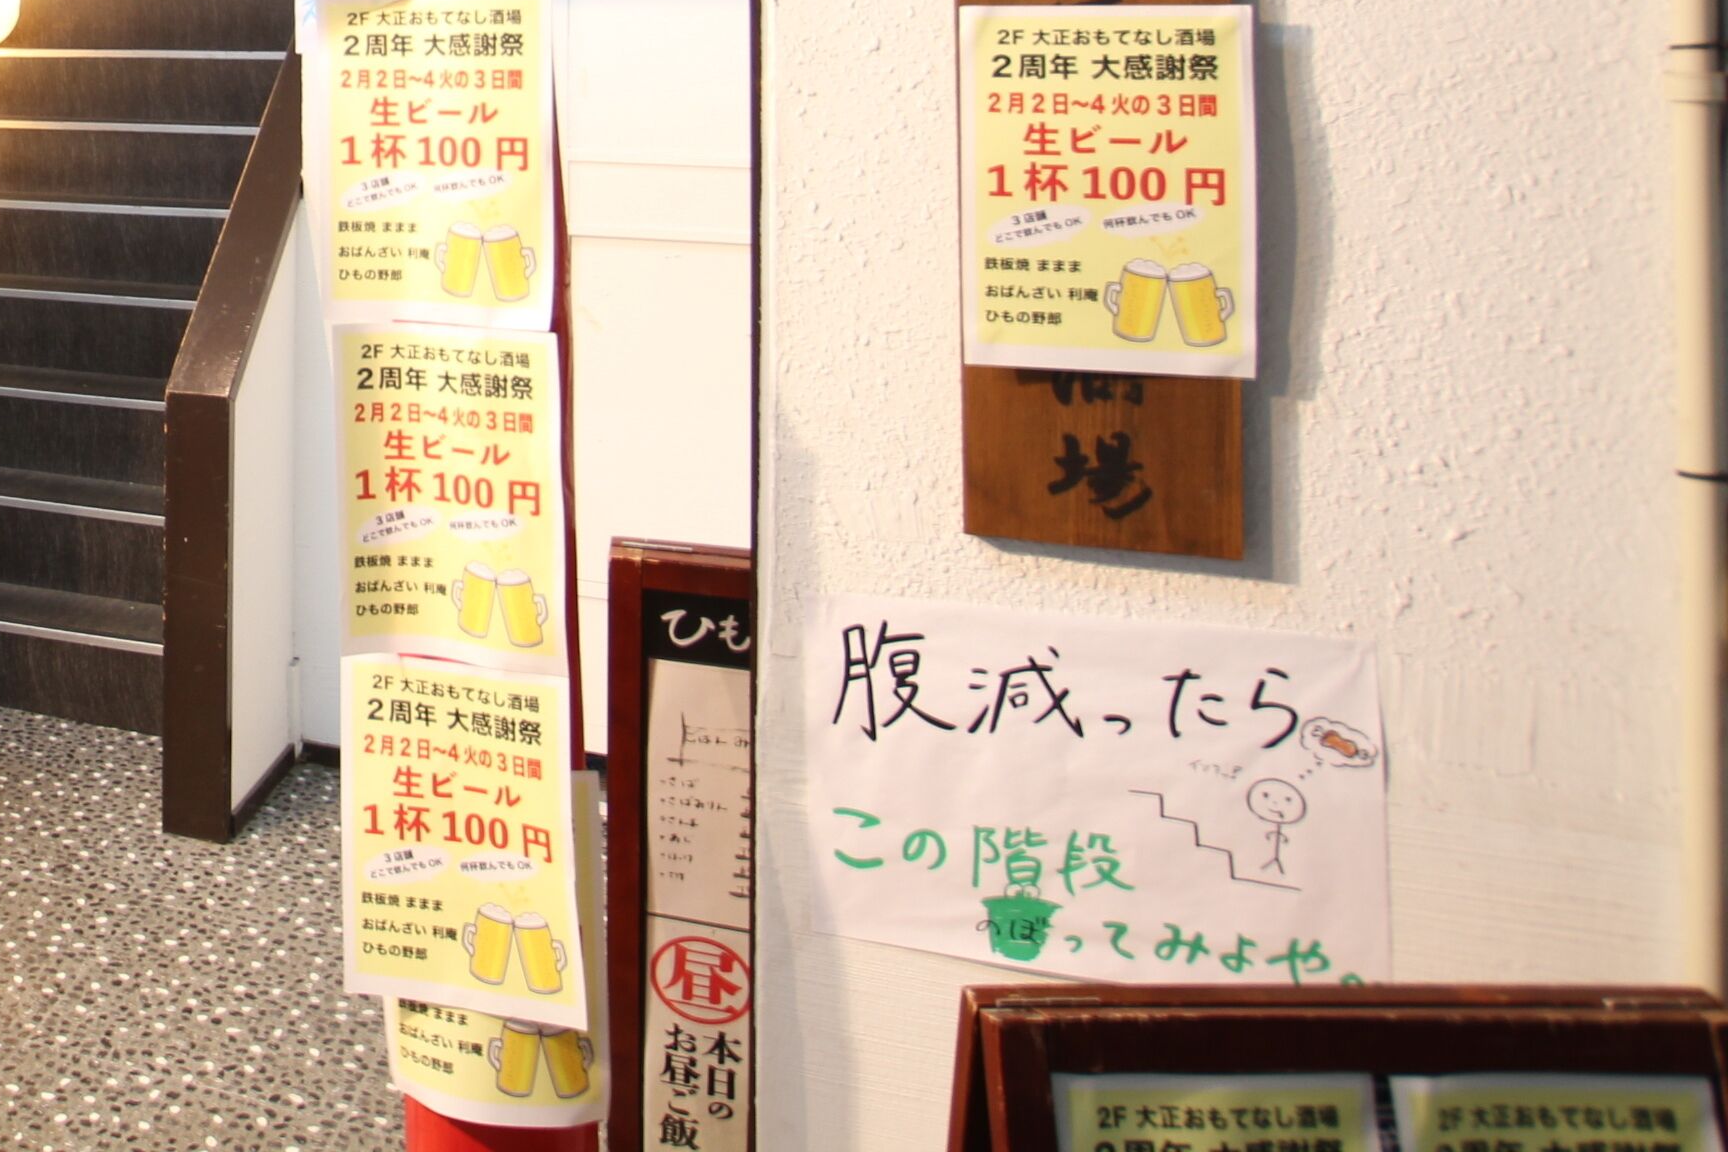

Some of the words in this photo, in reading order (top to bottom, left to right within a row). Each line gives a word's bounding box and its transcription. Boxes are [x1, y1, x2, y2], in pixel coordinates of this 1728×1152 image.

[347, 13, 368, 26] 2F
[375, 10, 521, 26] 大正おもてなし酒場
[343, 35, 413, 58] 2周年
[423, 32, 524, 57] 大感謝祭
[998, 30, 1023, 44] 2F
[1033, 29, 1215, 46] 大正おもてなし酒場
[991, 54, 1078, 80] 2周年
[1092, 54, 1218, 81] 大感謝祭
[371, 96, 498, 126] 生ビール
[1024, 123, 1188, 156] 生ビール
[985, 258, 1030, 272] 鉄板焼
[1038, 260, 1081, 273] ままま
[985, 286, 1061, 300] おばんざい
[1069, 288, 1098, 303] 利庵
[986, 310, 1062, 325] ひもの野郎
[361, 345, 381, 359] 2F
[389, 346, 530, 368] 大正おもてなし酒場
[356, 367, 424, 393] 2周年
[435, 372, 532, 400] 大感謝祭
[383, 430, 510, 465] 生ビール
[372, 675, 393, 691] 2F
[400, 679, 539, 713] 大正おもてなし酒場
[833, 620, 1299, 749] 腹減ったら
[367, 697, 435, 731] 2周年
[445, 709, 541, 746] 大感謝祭
[393, 766, 520, 808] 生ビール
[832, 806, 1135, 895] この階段
[664, 942, 741, 1013] 昼
[659, 1023, 700, 1151] お昼ご飯
[702, 1032, 741, 1122] 本日の
[1097, 1107, 1128, 1127] 2F
[1137, 1106, 1339, 1130] 大正おもてなし酒場
